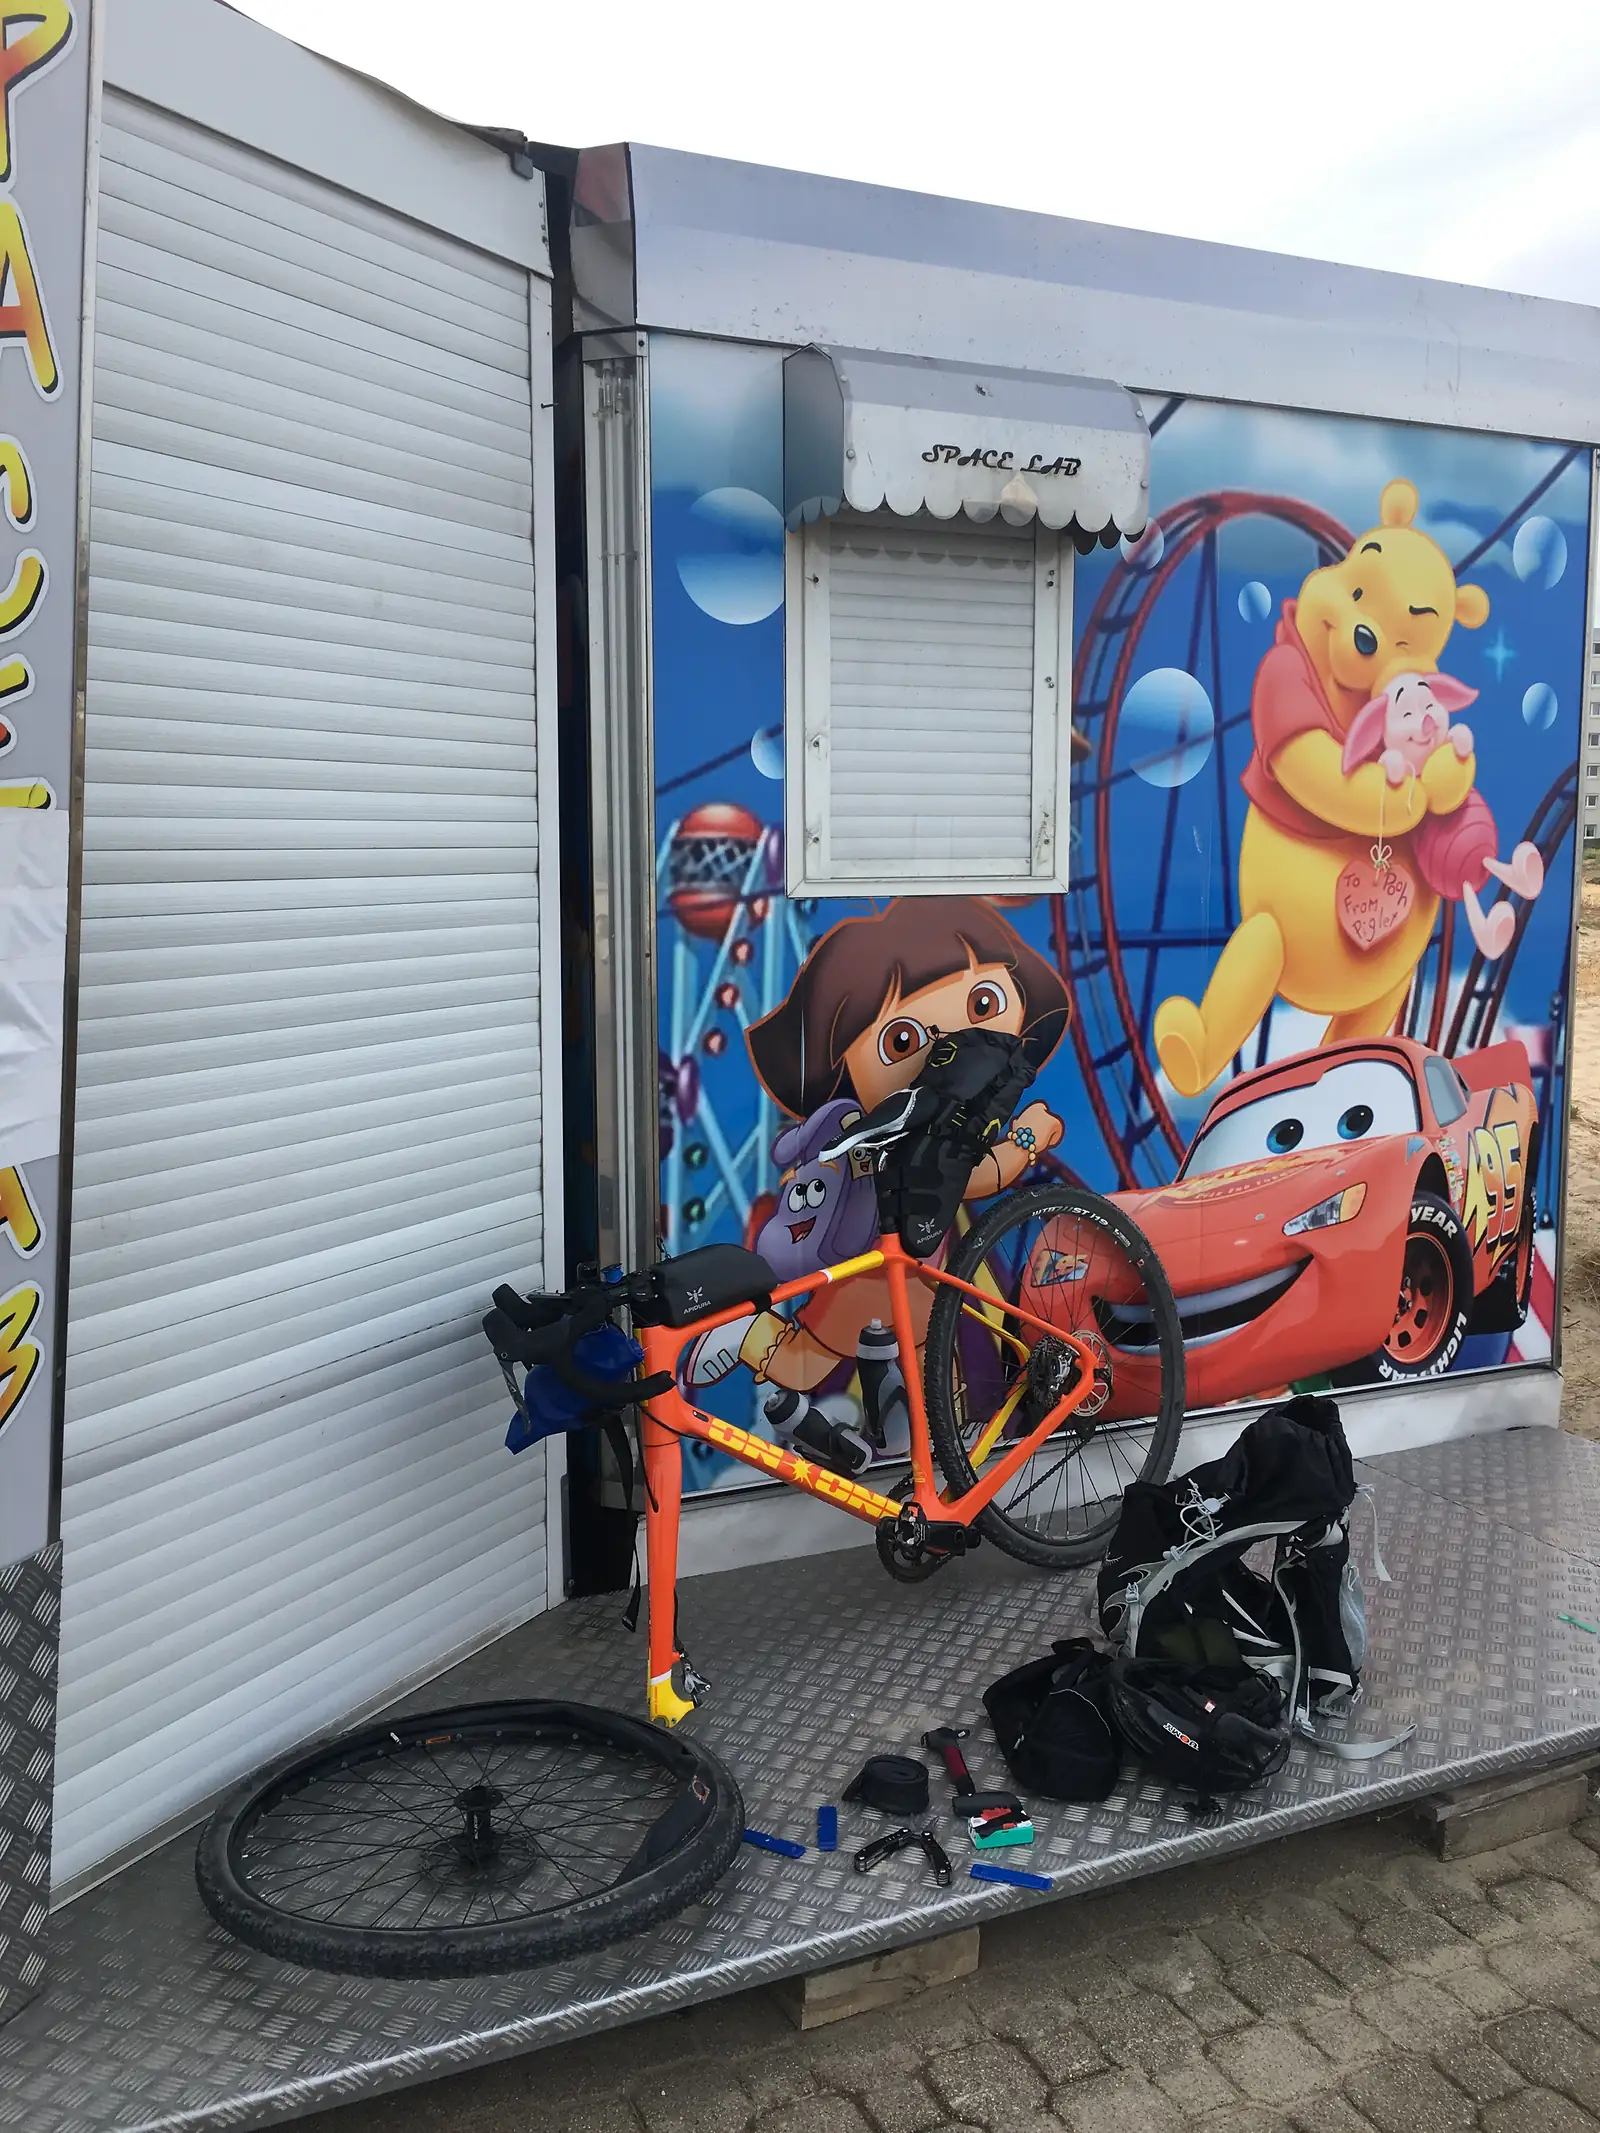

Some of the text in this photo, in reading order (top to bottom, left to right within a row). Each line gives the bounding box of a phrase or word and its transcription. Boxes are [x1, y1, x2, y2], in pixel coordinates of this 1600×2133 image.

[921, 444, 1082, 476] SPACE LAB
[1343, 872, 1408, 907] To Pooh
[1352, 906, 1398, 942] Piglet
[1474, 1121, 1523, 1244] 95
[916, 1229, 943, 1245] APIDURA
[683, 1300, 712, 1315] APIDURA
[708, 1417, 784, 1470] ON
